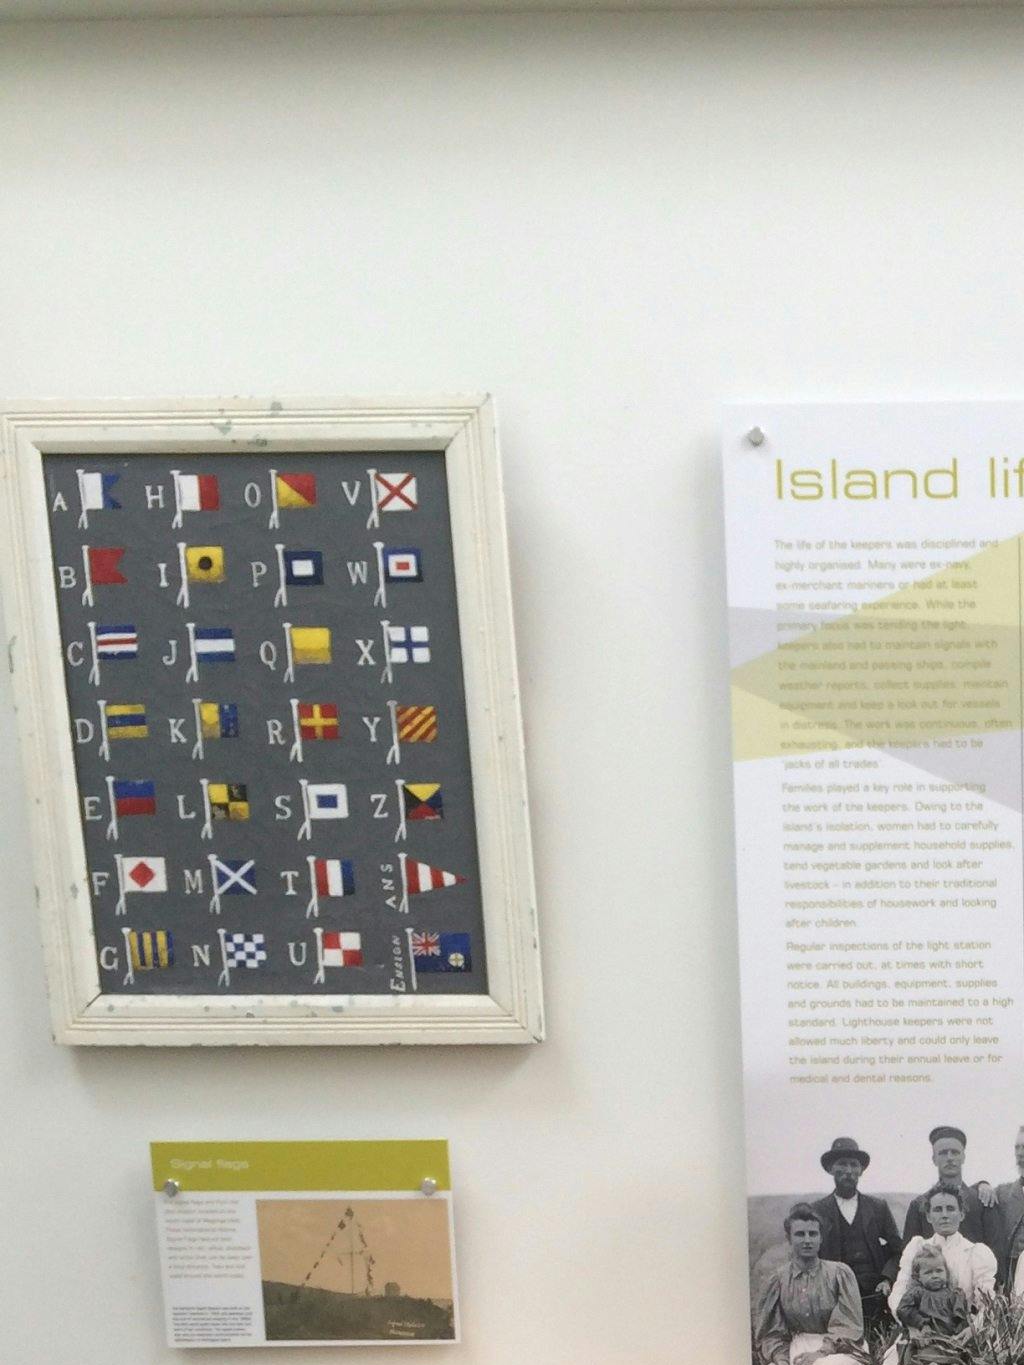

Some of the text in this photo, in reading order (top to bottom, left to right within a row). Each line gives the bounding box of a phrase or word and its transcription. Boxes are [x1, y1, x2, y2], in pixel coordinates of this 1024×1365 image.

[776, 458, 958, 500] Island
[53, 492, 67, 512] A
[145, 486, 164, 509] H
[244, 482, 261, 507] O
[342, 481, 360, 506] V
[58, 566, 76, 588] B
[158, 563, 169, 587] I
[251, 562, 267, 587] P
[347, 561, 367, 585] W
[68, 642, 84, 666] C
[162, 640, 177, 665] J
[260, 641, 276, 670] Q
[356, 640, 376, 666] X
[74, 718, 94, 743] D
[168, 719, 187, 743] K
[266, 720, 285, 744] R
[362, 717, 380, 742] Y
[84, 796, 102, 820] E
[177, 795, 196, 819] L
[275, 796, 292, 820] S
[370, 794, 388, 818] Z
[92, 872, 110, 895] F
[184, 869, 203, 894] M
[280, 871, 299, 895] T
[381, 863, 398, 909] ANS
[100, 946, 118, 970] G
[192, 944, 210, 966] N
[288, 942, 306, 966] U
